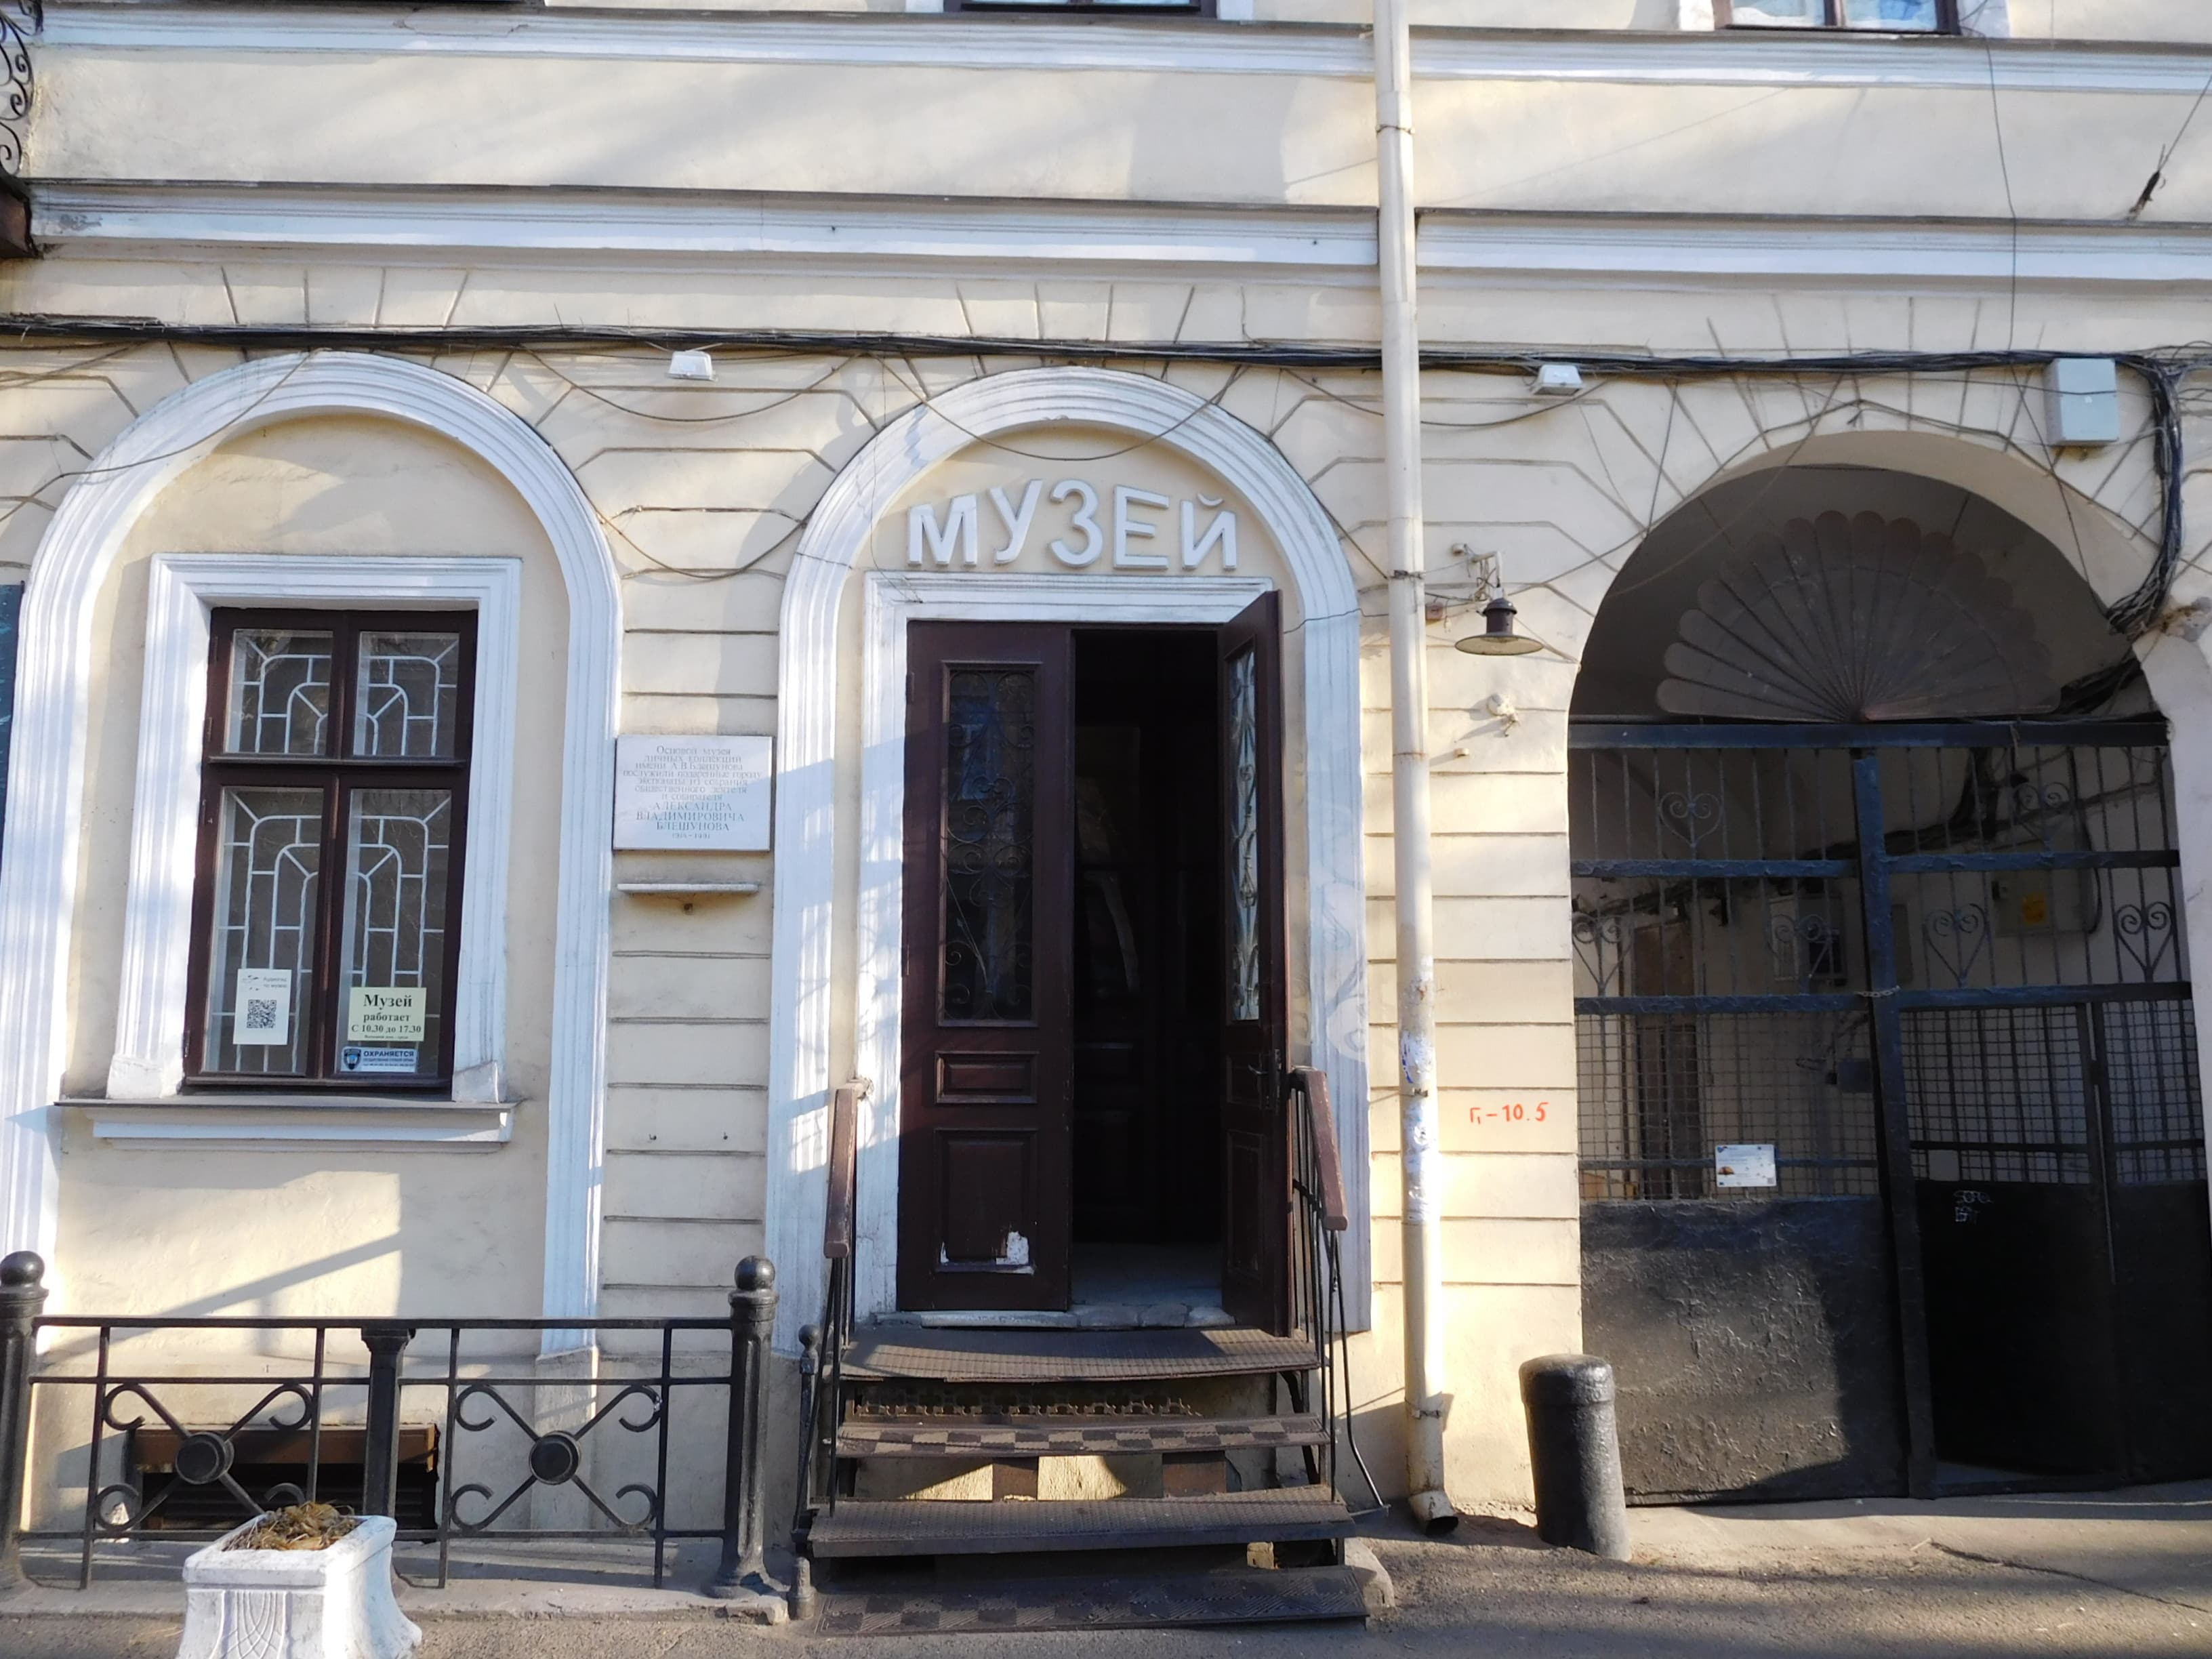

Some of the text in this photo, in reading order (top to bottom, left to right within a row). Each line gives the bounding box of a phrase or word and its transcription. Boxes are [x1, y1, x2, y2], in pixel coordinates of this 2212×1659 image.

[907, 478, 1237, 571] МУЗЕЙ
[703, 747, 731, 756] музея
[653, 802, 733, 811] АЛЕКСАНДРА
[636, 811, 745, 822] ВЛАДИМИРОВИЧА
[363, 994, 412, 1010] Музей
[363, 1012, 411, 1023] работает
